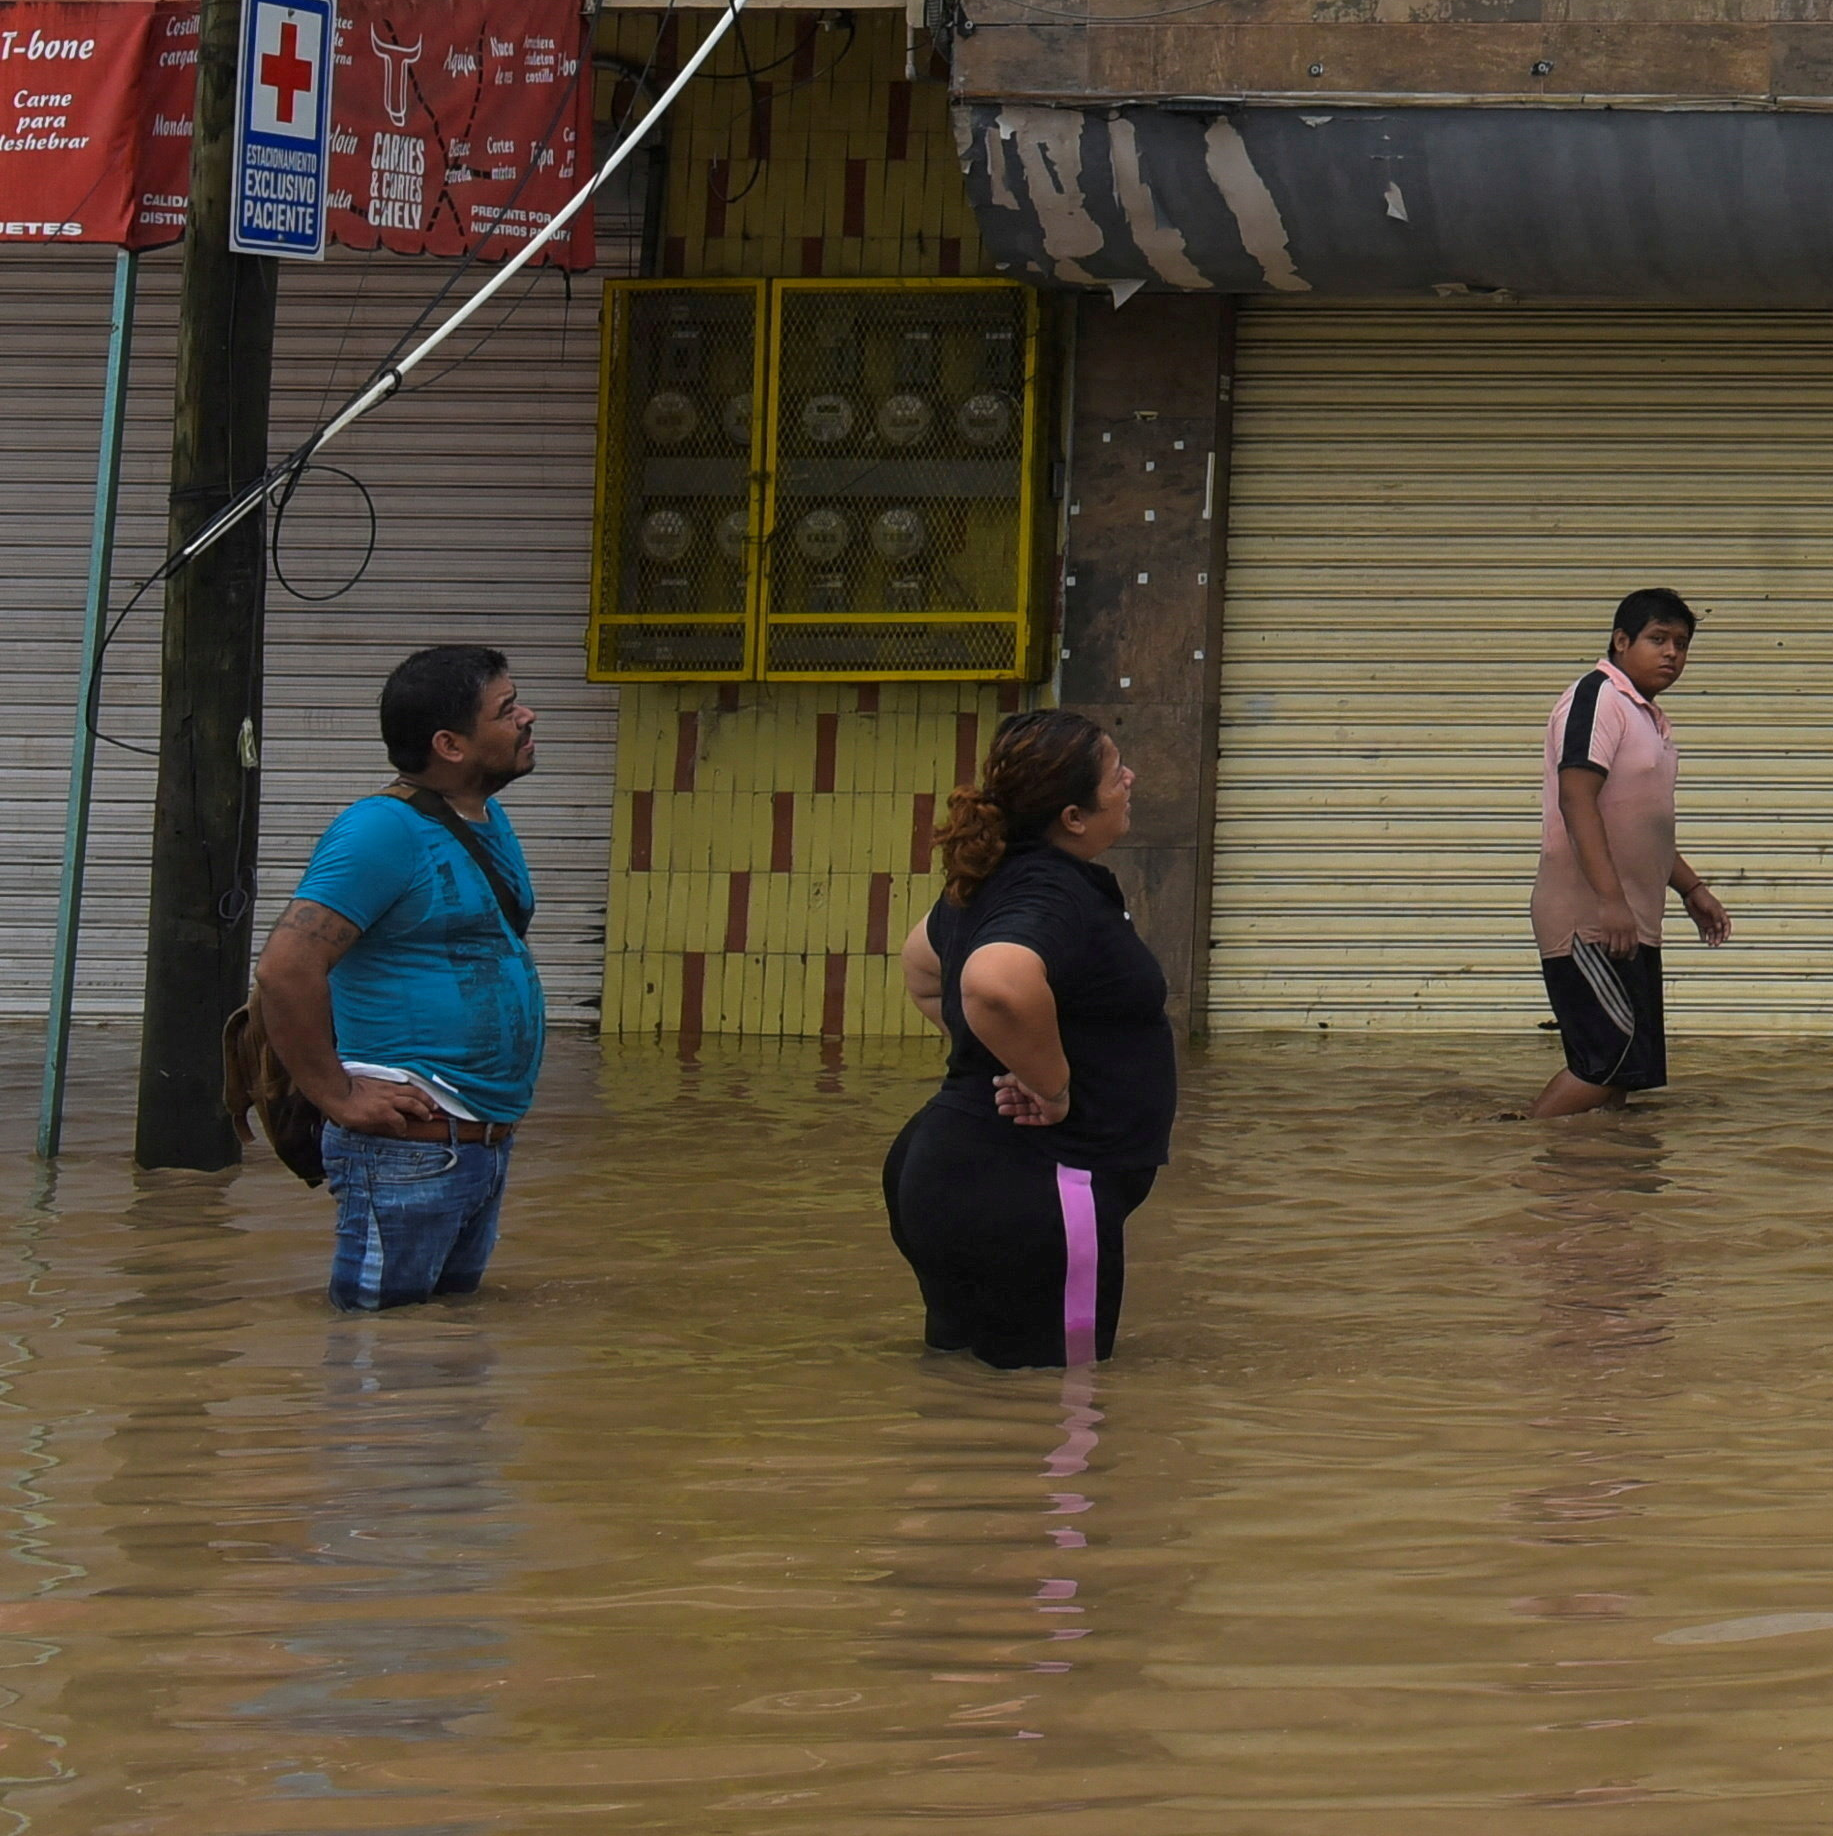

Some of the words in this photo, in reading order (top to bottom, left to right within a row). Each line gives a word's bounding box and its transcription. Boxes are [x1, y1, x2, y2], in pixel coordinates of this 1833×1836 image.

[1, 29, 95, 61] T-bone
[490, 36, 514, 58] Nuca
[443, 45, 477, 78] Aguja
[14, 89, 73, 108] Carne
[16, 115, 66, 134] para
[246, 144, 317, 174] ESTACIONAMIENTO
[371, 132, 425, 176] CARNES
[487, 137, 515, 154] Cortes
[245, 168, 316, 204] EXCLUSIVO
[370, 171, 379, 197] &
[243, 200, 314, 235] PACIENTE
